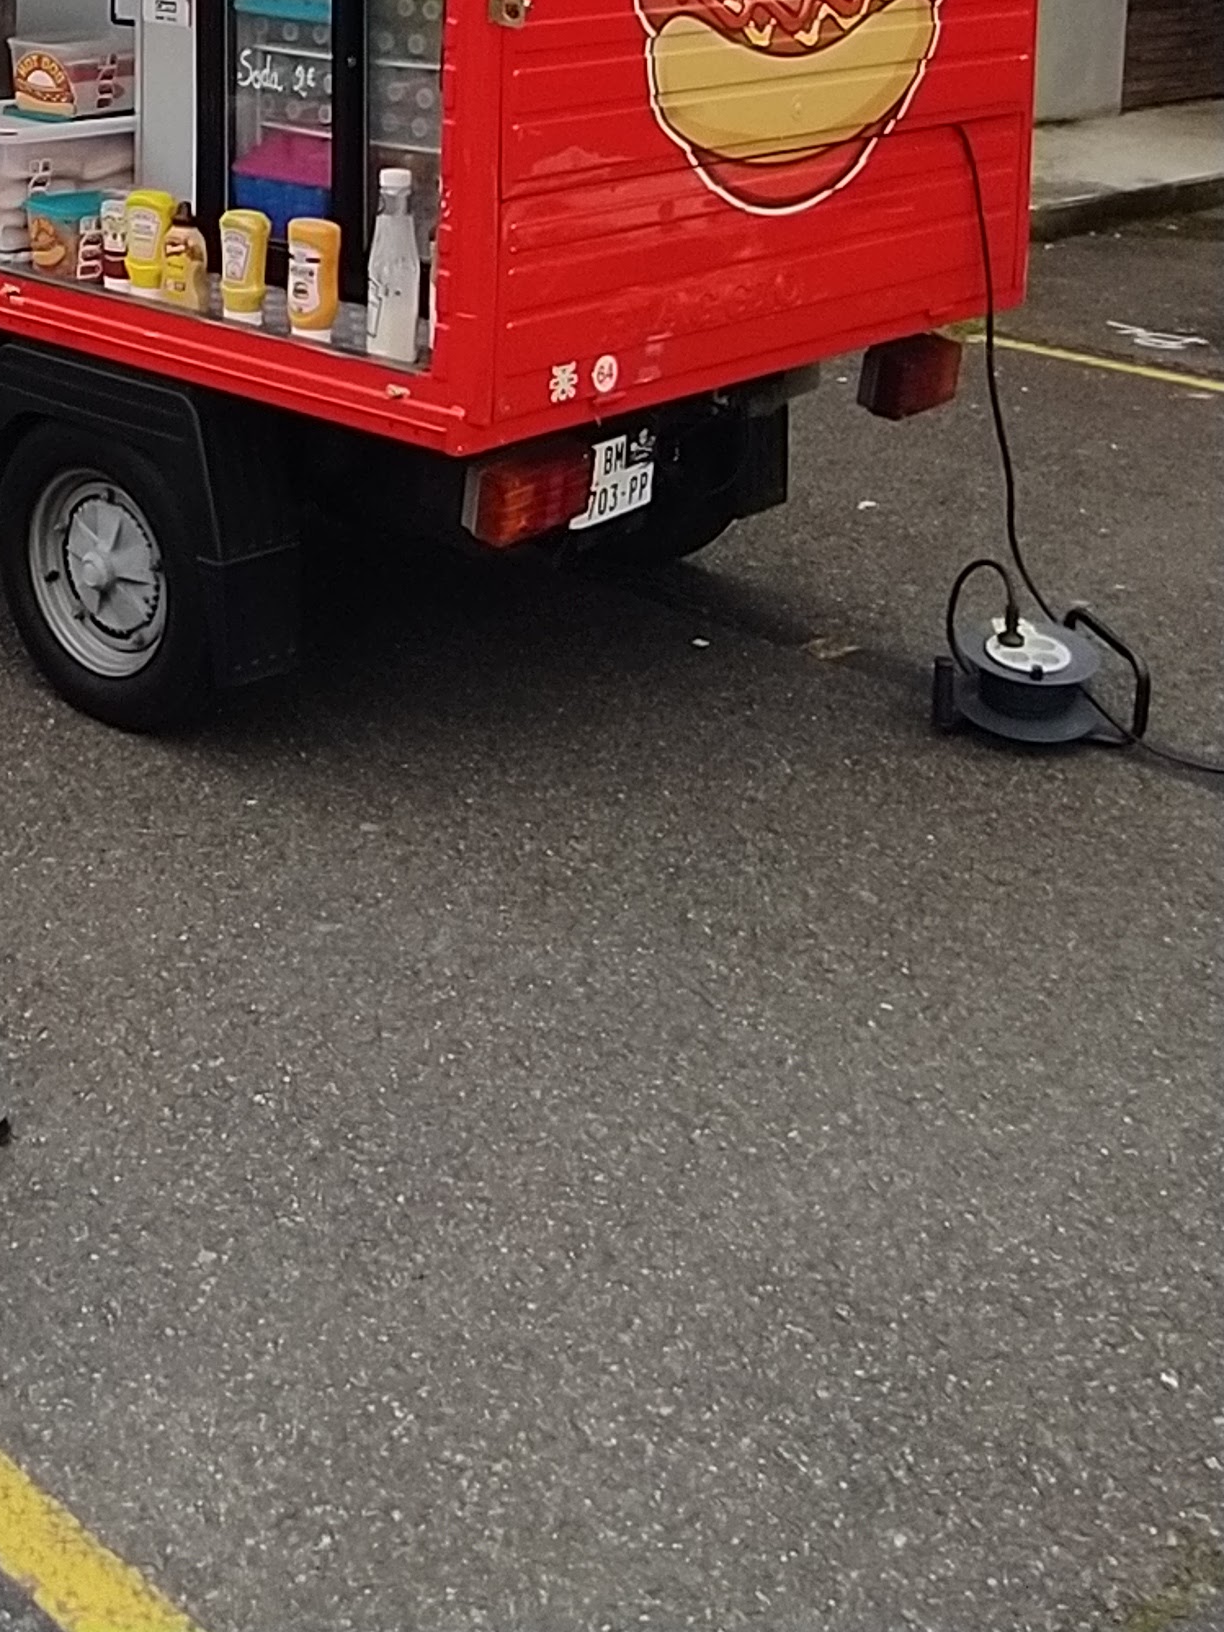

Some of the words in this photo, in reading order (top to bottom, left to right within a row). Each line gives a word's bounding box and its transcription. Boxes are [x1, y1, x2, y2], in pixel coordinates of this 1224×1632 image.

[18, 54, 39, 78] HOT
[40, 56, 65, 84] DOG
[236, 49, 284, 92] Soda
[603, 441, 626, 476] BM
